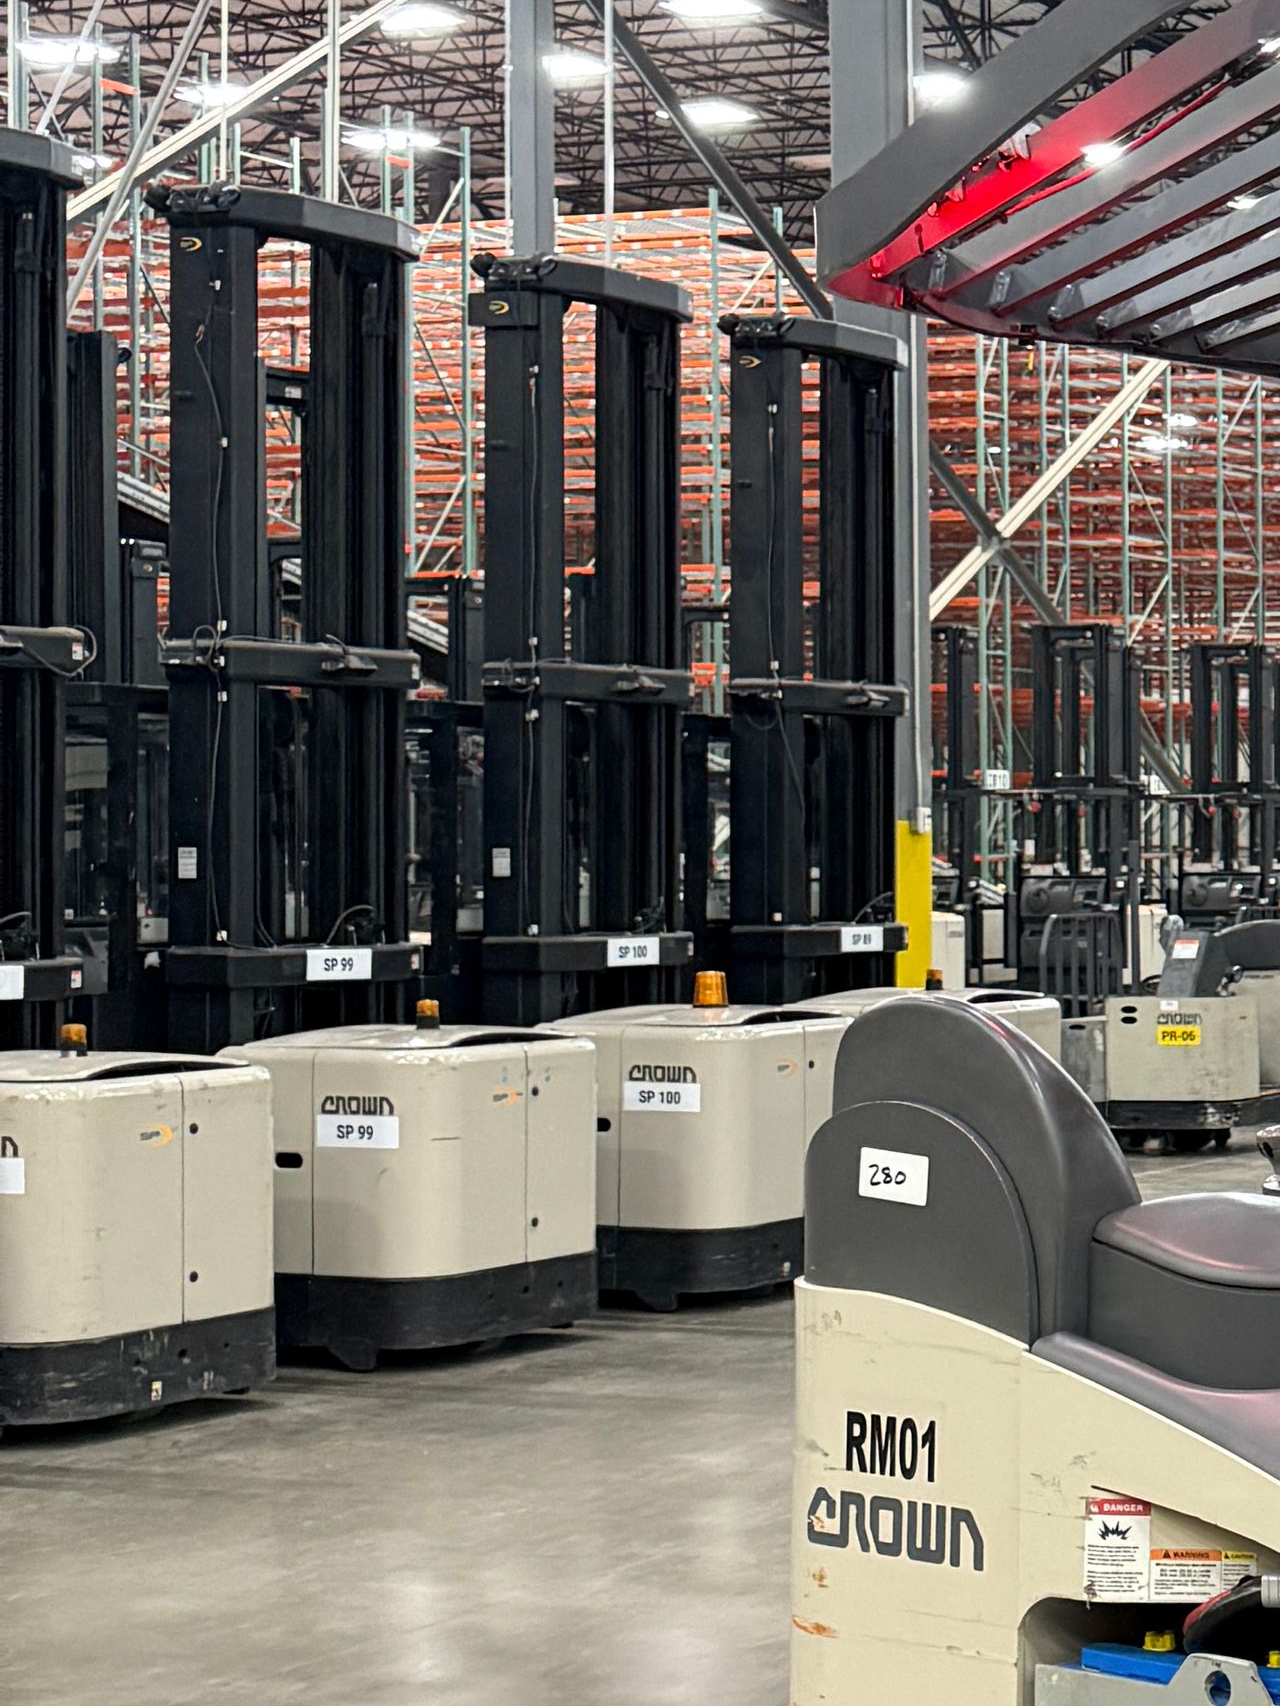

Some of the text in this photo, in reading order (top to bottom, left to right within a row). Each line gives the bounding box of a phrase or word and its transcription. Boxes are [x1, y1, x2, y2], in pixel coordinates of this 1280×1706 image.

[618, 945, 648, 959] SP 100
[323, 957, 354, 972] SP 99
[628, 1064, 697, 1083] CROWN
[321, 1095, 395, 1115] CROWN
[638, 1091, 681, 1104] SP 100
[336, 1125, 374, 1140] SP 99
[868, 1163, 907, 1186] 280
[846, 1411, 936, 1483] RM01
[1103, 1503, 1143, 1512] DANGER
[807, 1487, 984, 1572] CROWN
